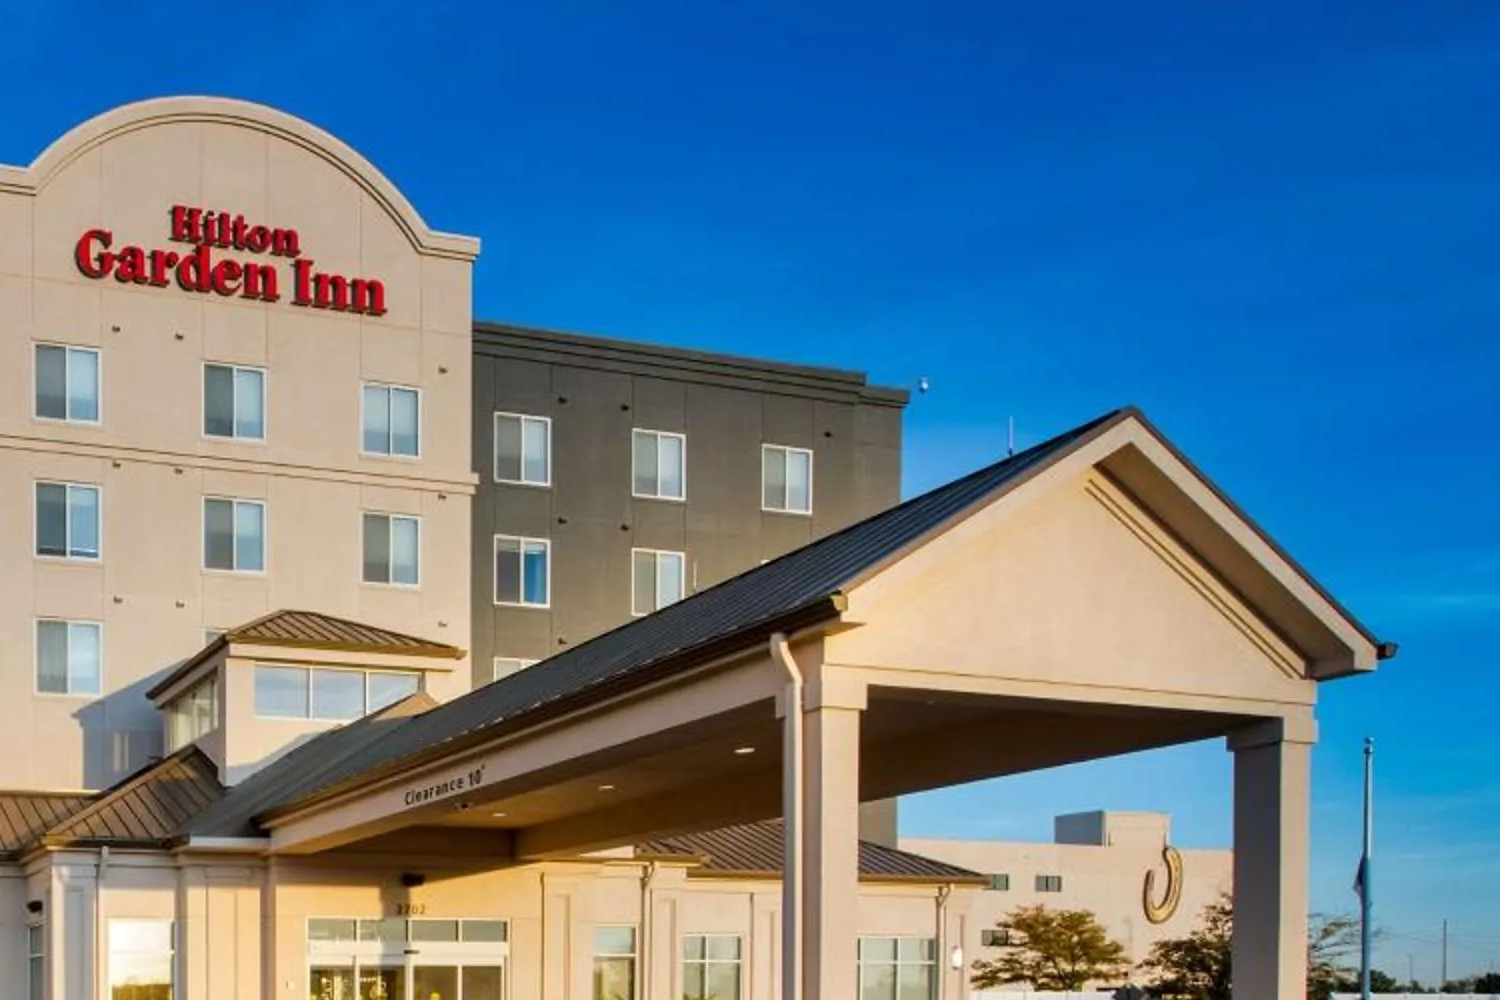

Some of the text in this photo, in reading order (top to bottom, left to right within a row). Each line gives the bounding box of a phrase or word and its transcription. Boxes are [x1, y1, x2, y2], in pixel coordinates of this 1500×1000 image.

[169, 205, 300, 257] Hilton
[75, 229, 387, 316] Garden Inn
[404, 777, 464, 806] Clearance
